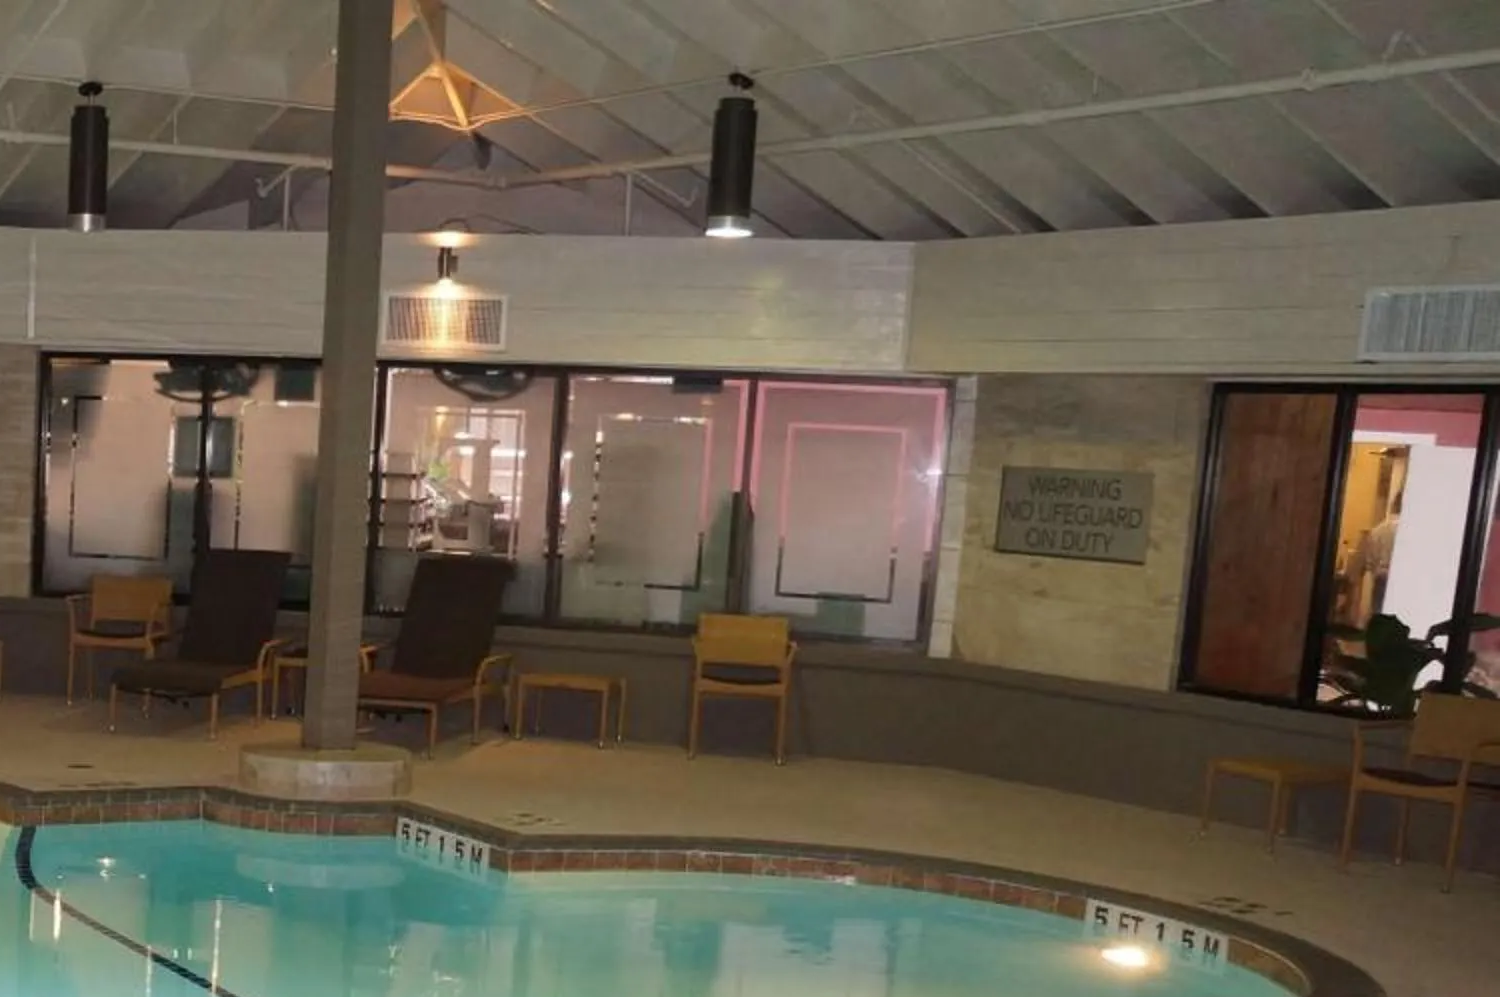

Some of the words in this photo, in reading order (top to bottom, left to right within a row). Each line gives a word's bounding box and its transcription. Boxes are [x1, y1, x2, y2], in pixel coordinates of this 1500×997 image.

[1028, 476, 1123, 501] WARNING
[1004, 500, 1034, 521] NO
[1038, 502, 1143, 529] LIFEGUARD
[1025, 527, 1056, 549] ON
[1061, 529, 1113, 553] DUTY
[1094, 906, 1109, 926] 5
[1118, 913, 1144, 935] FT
